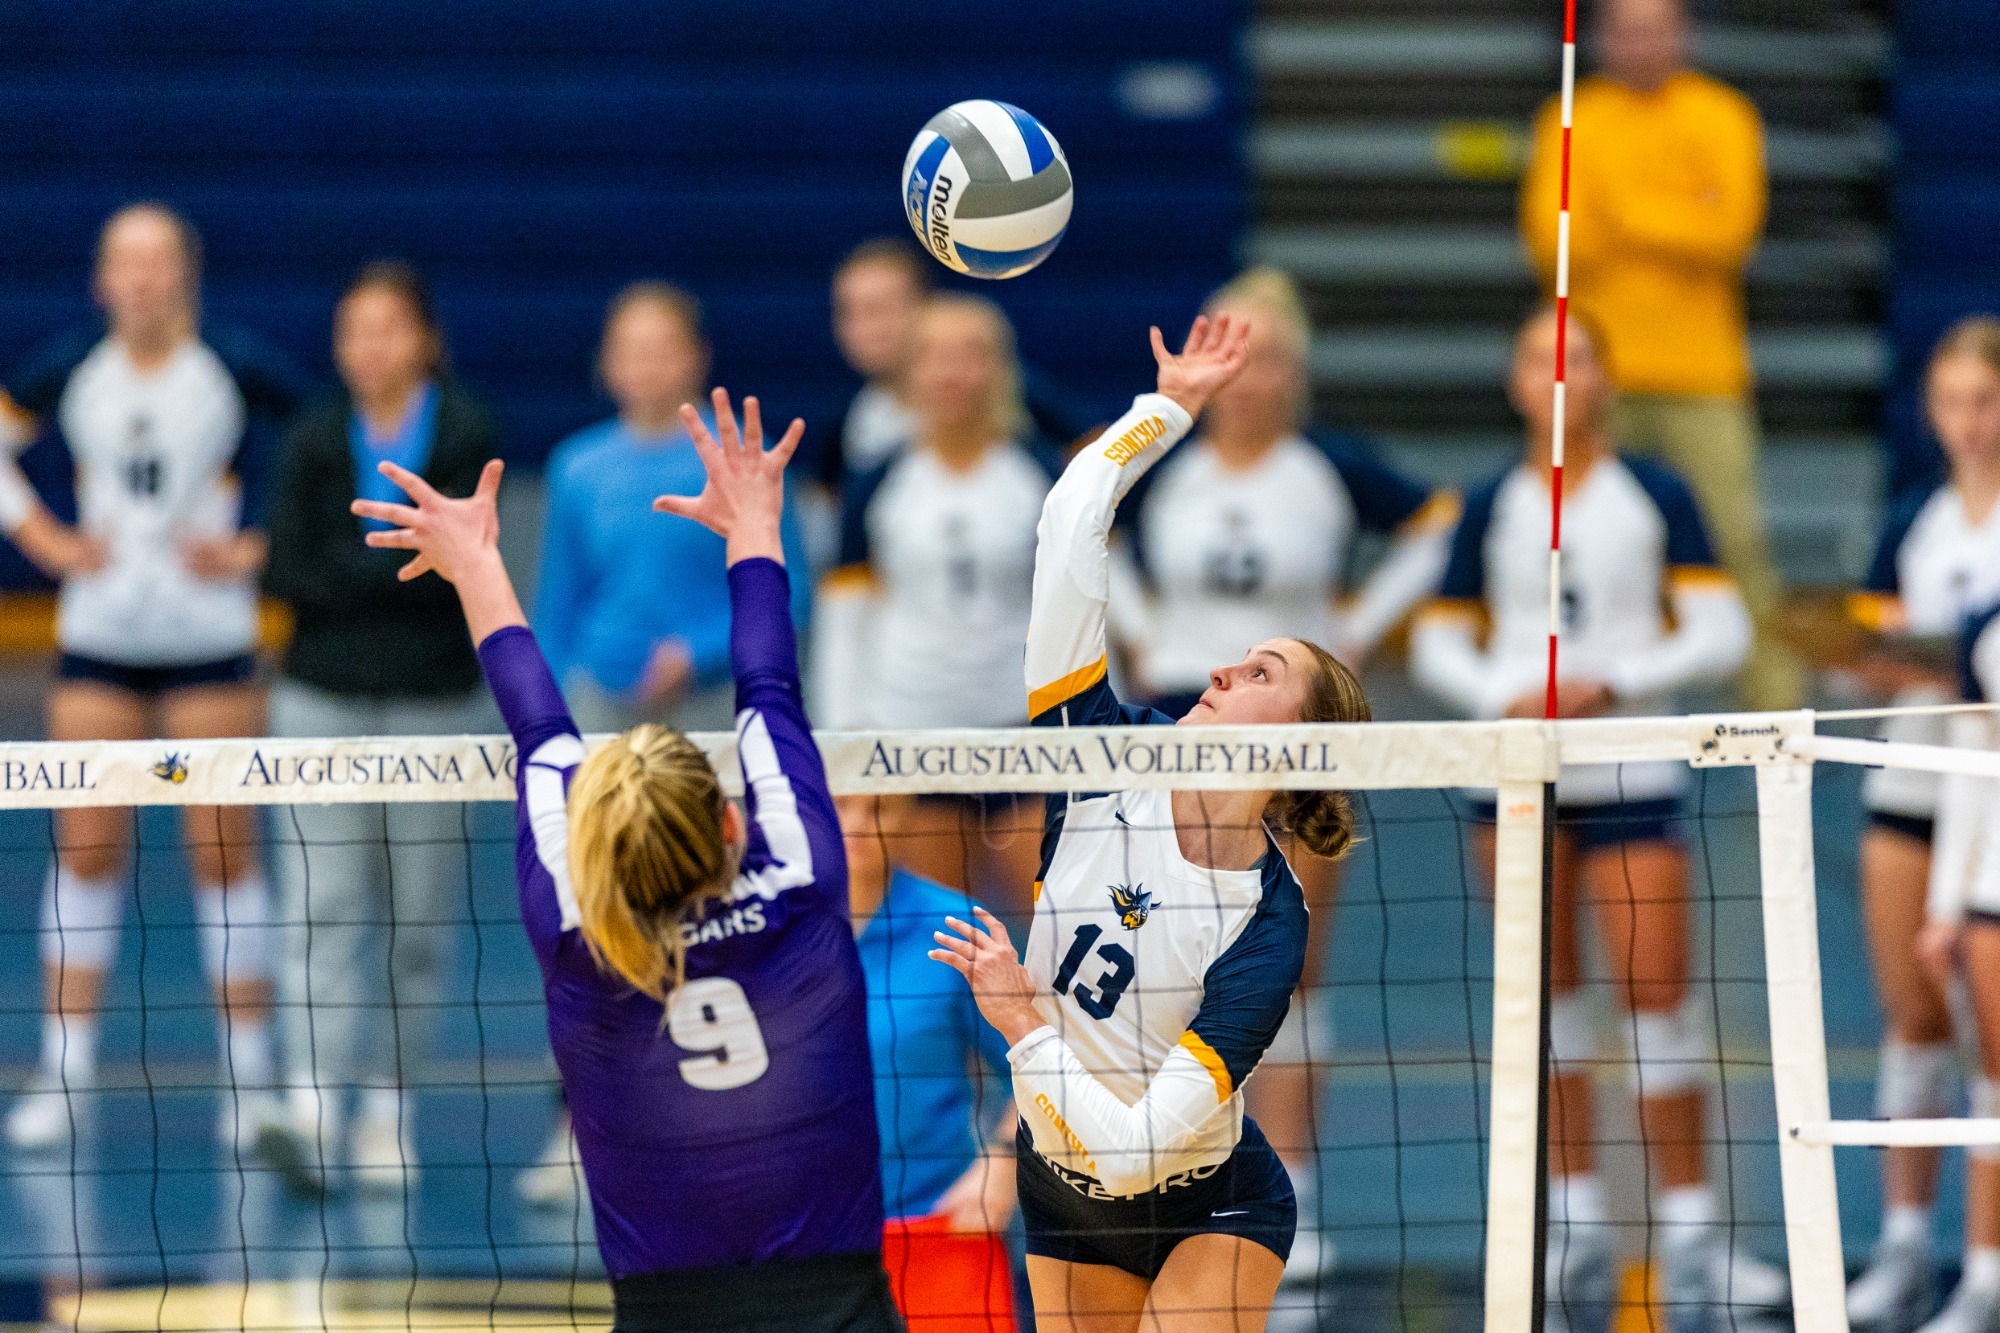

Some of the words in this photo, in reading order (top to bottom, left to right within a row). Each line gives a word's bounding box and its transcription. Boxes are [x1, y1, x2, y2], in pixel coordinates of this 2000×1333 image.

[931, 174, 956, 266] molten
[1103, 415, 1167, 467] VIKINGS
[239, 749, 464, 786] AUGUSTANA
[860, 739, 1087, 777] AUGUSTANA
[1097, 735, 1338, 774] VOLLEYBALL
[680, 902, 767, 946] GARS
[1052, 923, 1136, 1021] 13
[666, 976, 769, 1091] 9
